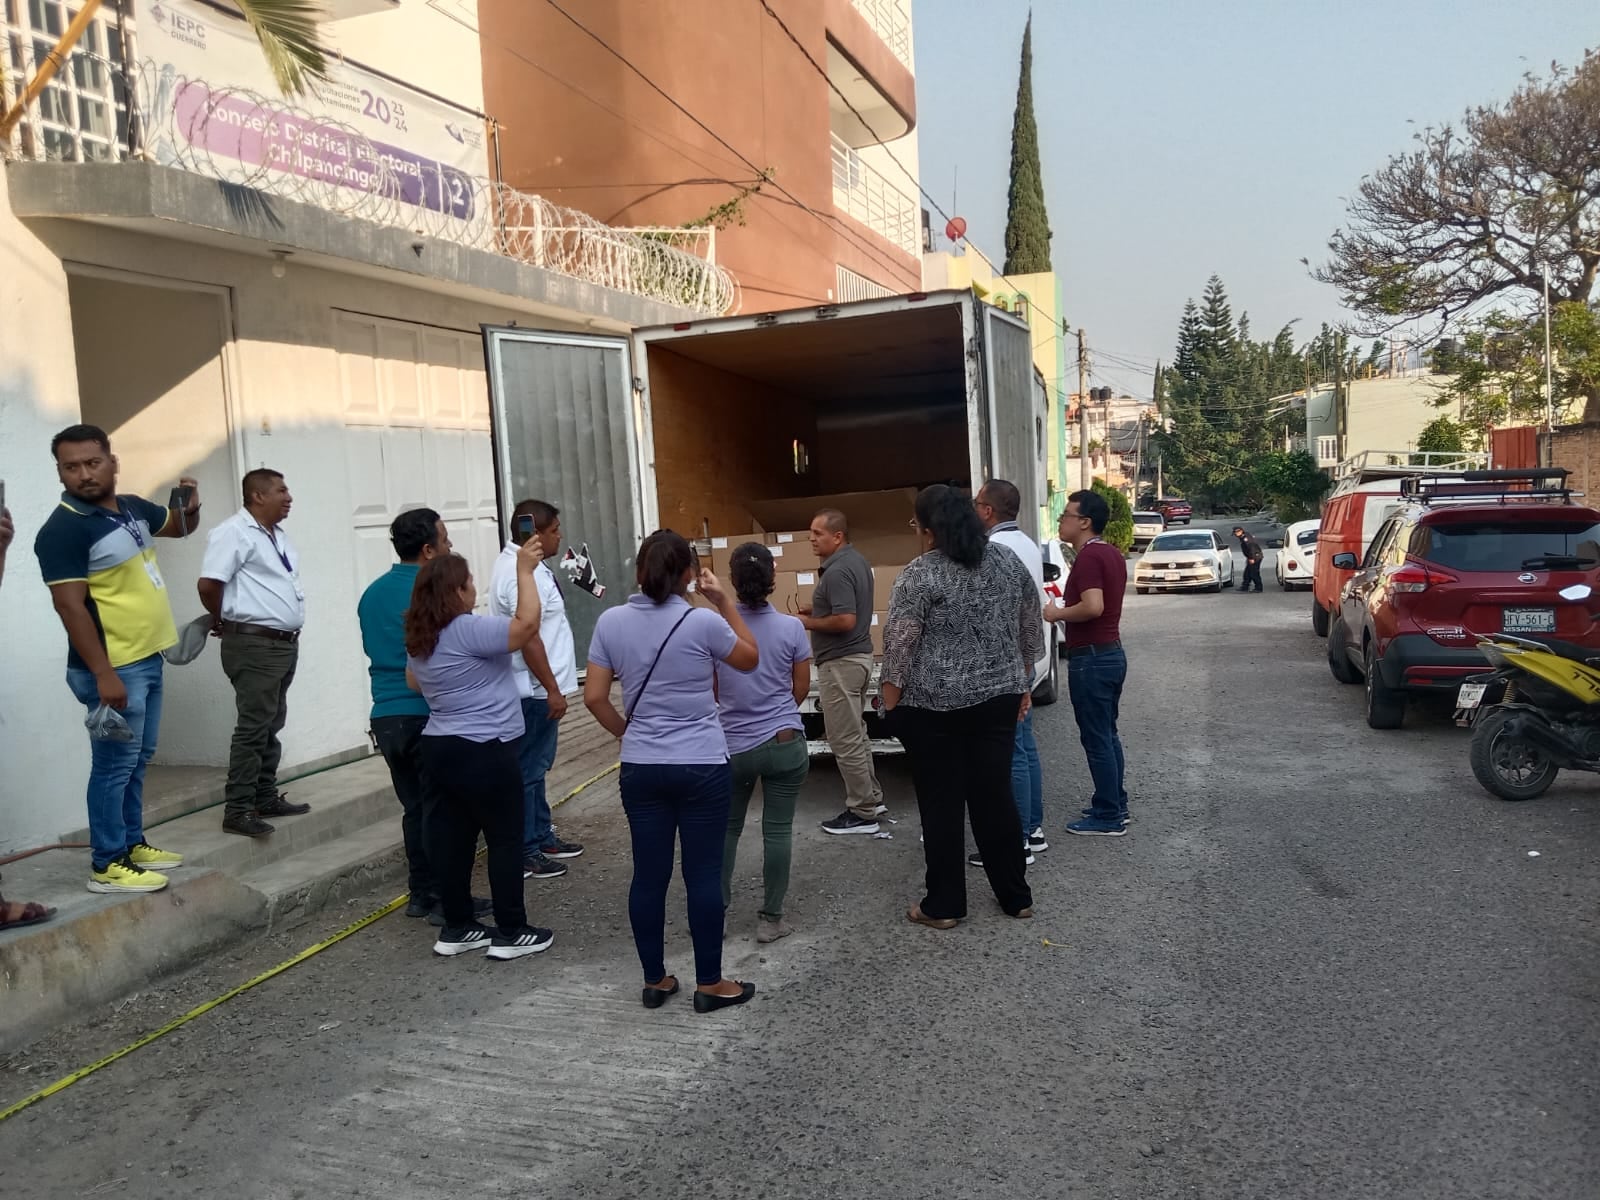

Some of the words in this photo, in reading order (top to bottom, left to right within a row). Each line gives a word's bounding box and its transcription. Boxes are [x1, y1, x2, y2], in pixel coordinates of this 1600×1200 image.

[171, 12, 206, 38] IEPC
[171, 30, 207, 50] GUERRERO
[321, 87, 361, 103] putaciones
[360, 89, 391, 125] 20
[391, 101, 405, 116] 23
[394, 117, 408, 133] 24
[203, 100, 280, 138] Consejo
[284, 122, 352, 158] Distrital
[356, 146, 421, 177] Elctoral
[269, 143, 380, 188] Chilpancingo
[452, 178, 465, 206] 2
